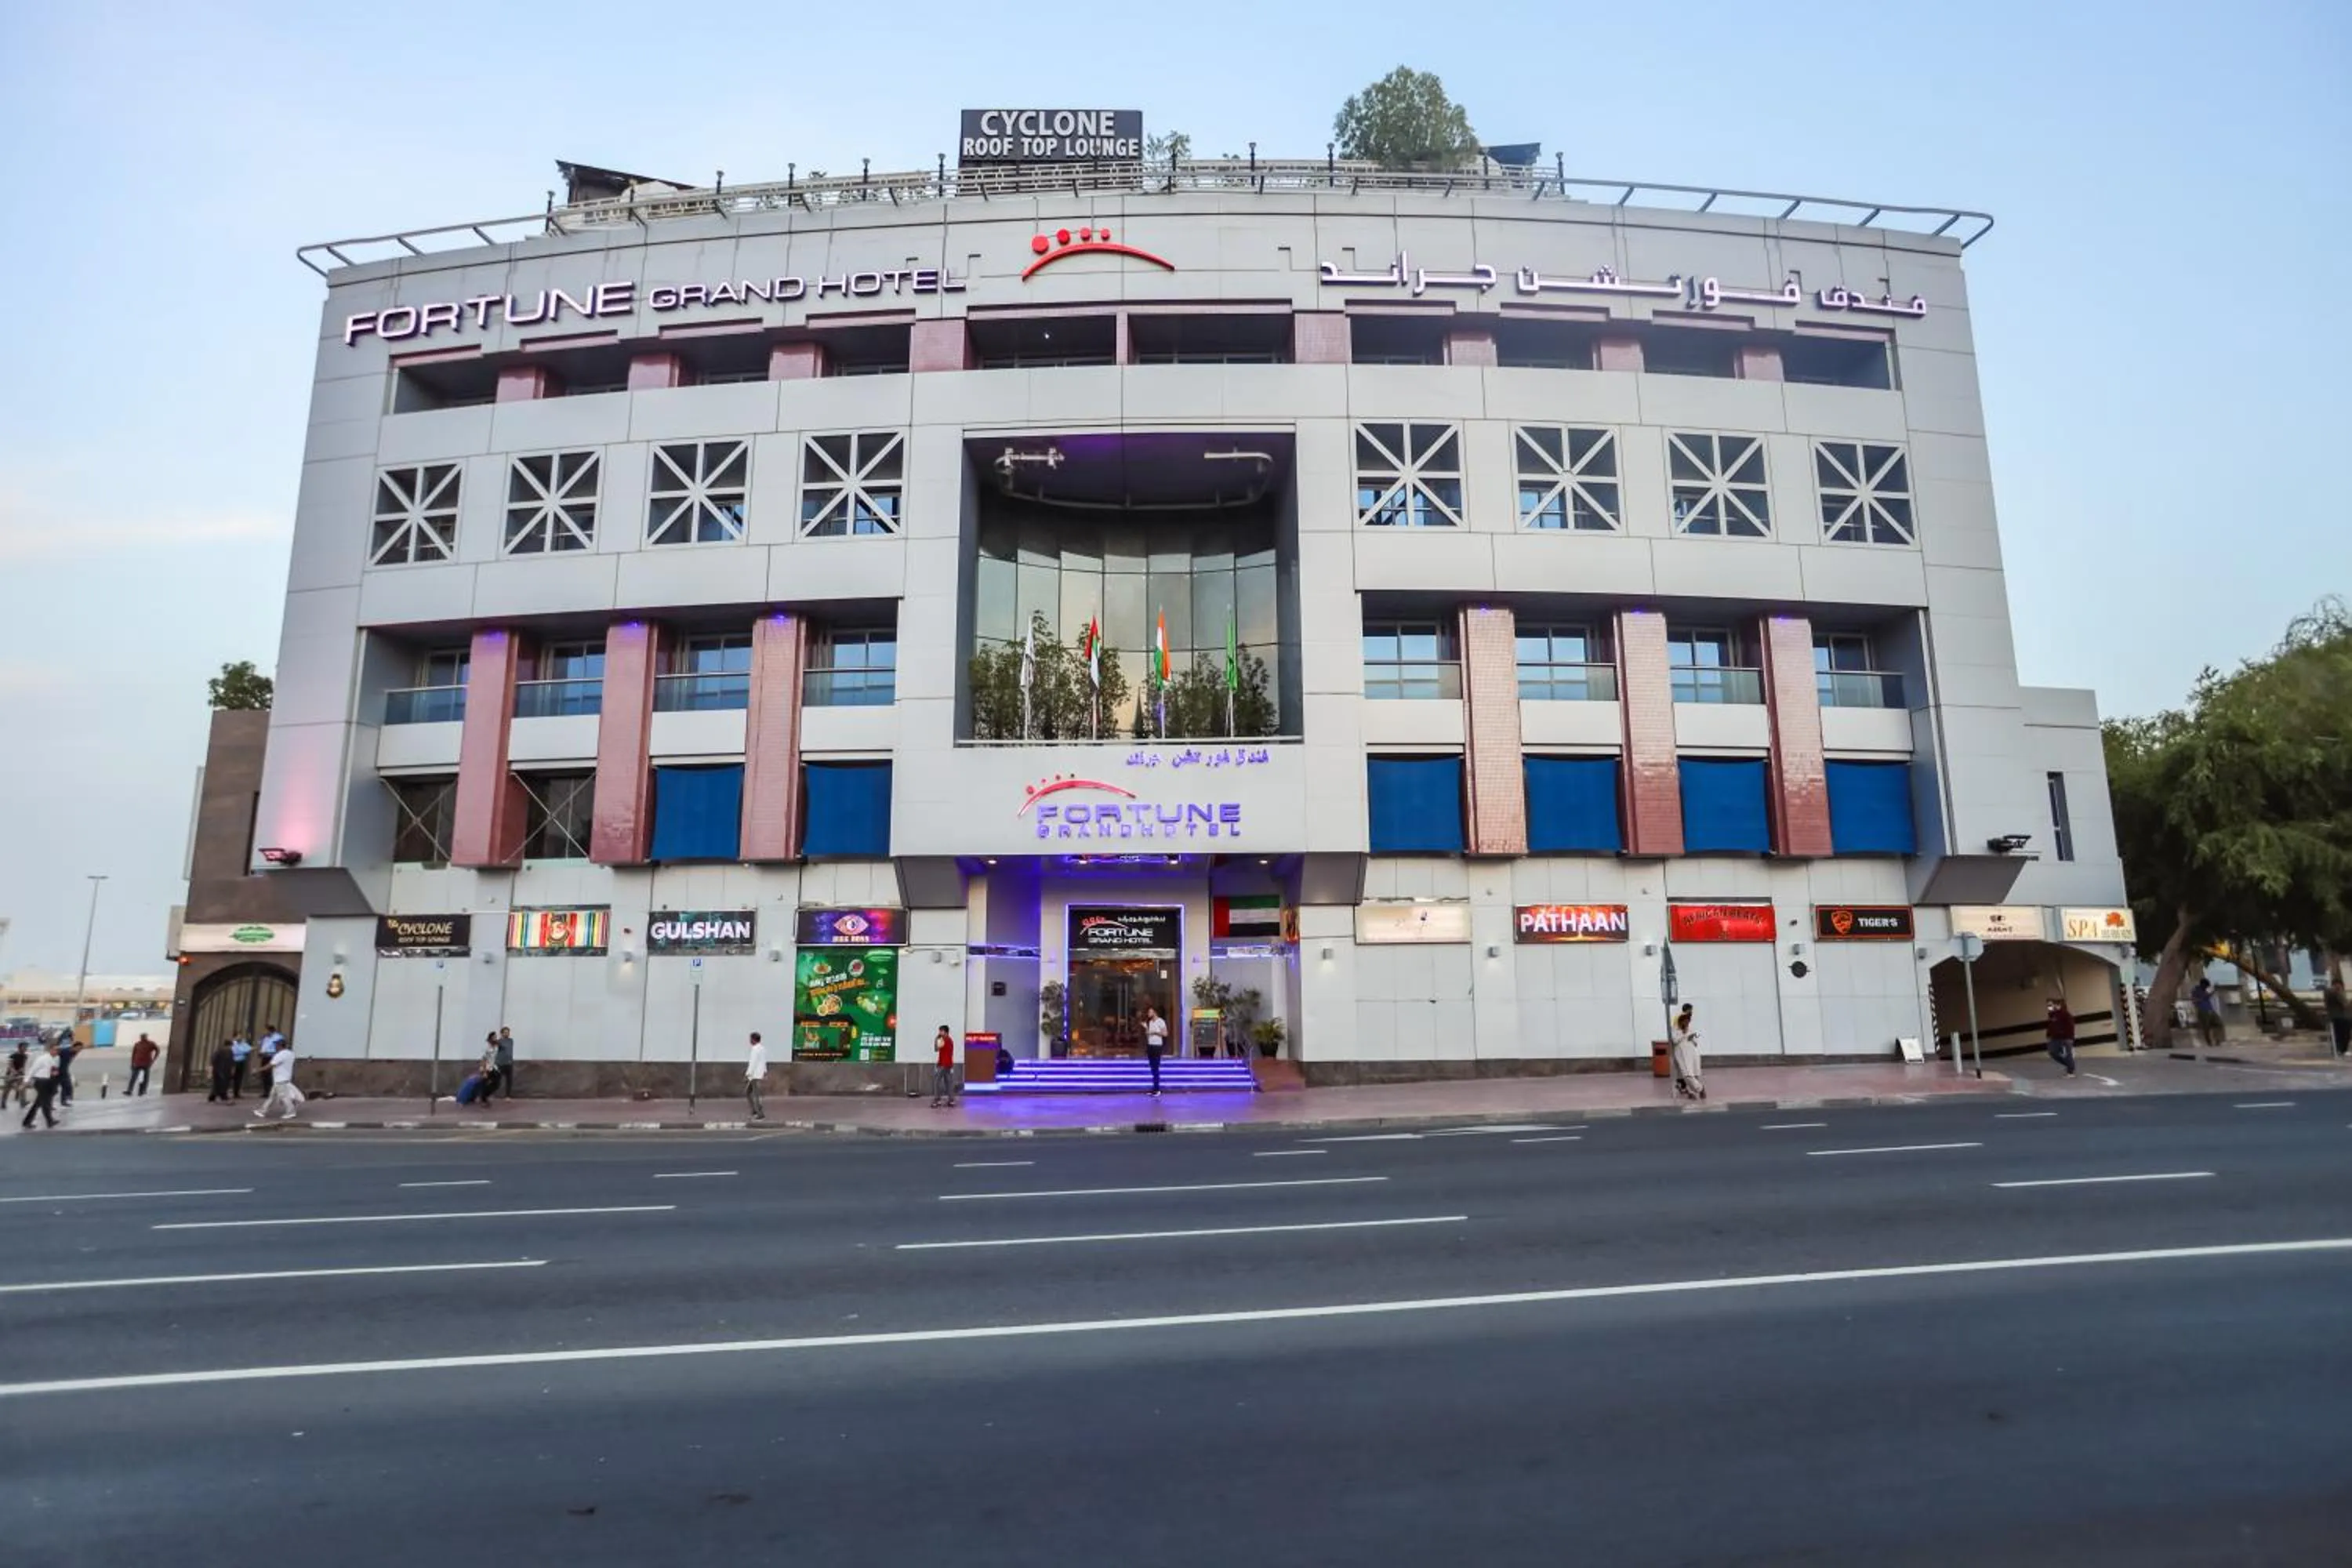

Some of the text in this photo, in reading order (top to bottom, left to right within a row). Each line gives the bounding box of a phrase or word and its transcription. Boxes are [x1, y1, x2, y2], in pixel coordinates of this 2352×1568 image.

[980, 111, 1116, 136] CYCLONE
[963, 137, 1139, 156] ROOF TOP LOUNGE
[1320, 249, 1497, 297] جراند
[345, 268, 966, 347] FORTUNE GRAND HOTEL
[1817, 285, 1927, 318] فندق
[1036, 803, 1241, 823] FORTUNE
[397, 922, 453, 935] CYCLONE
[650, 921, 750, 939] GULSHAN
[1087, 928, 1153, 937] FORTUNE
[1520, 913, 1626, 932] PATHAAN
[2067, 918, 2098, 938] SPA
